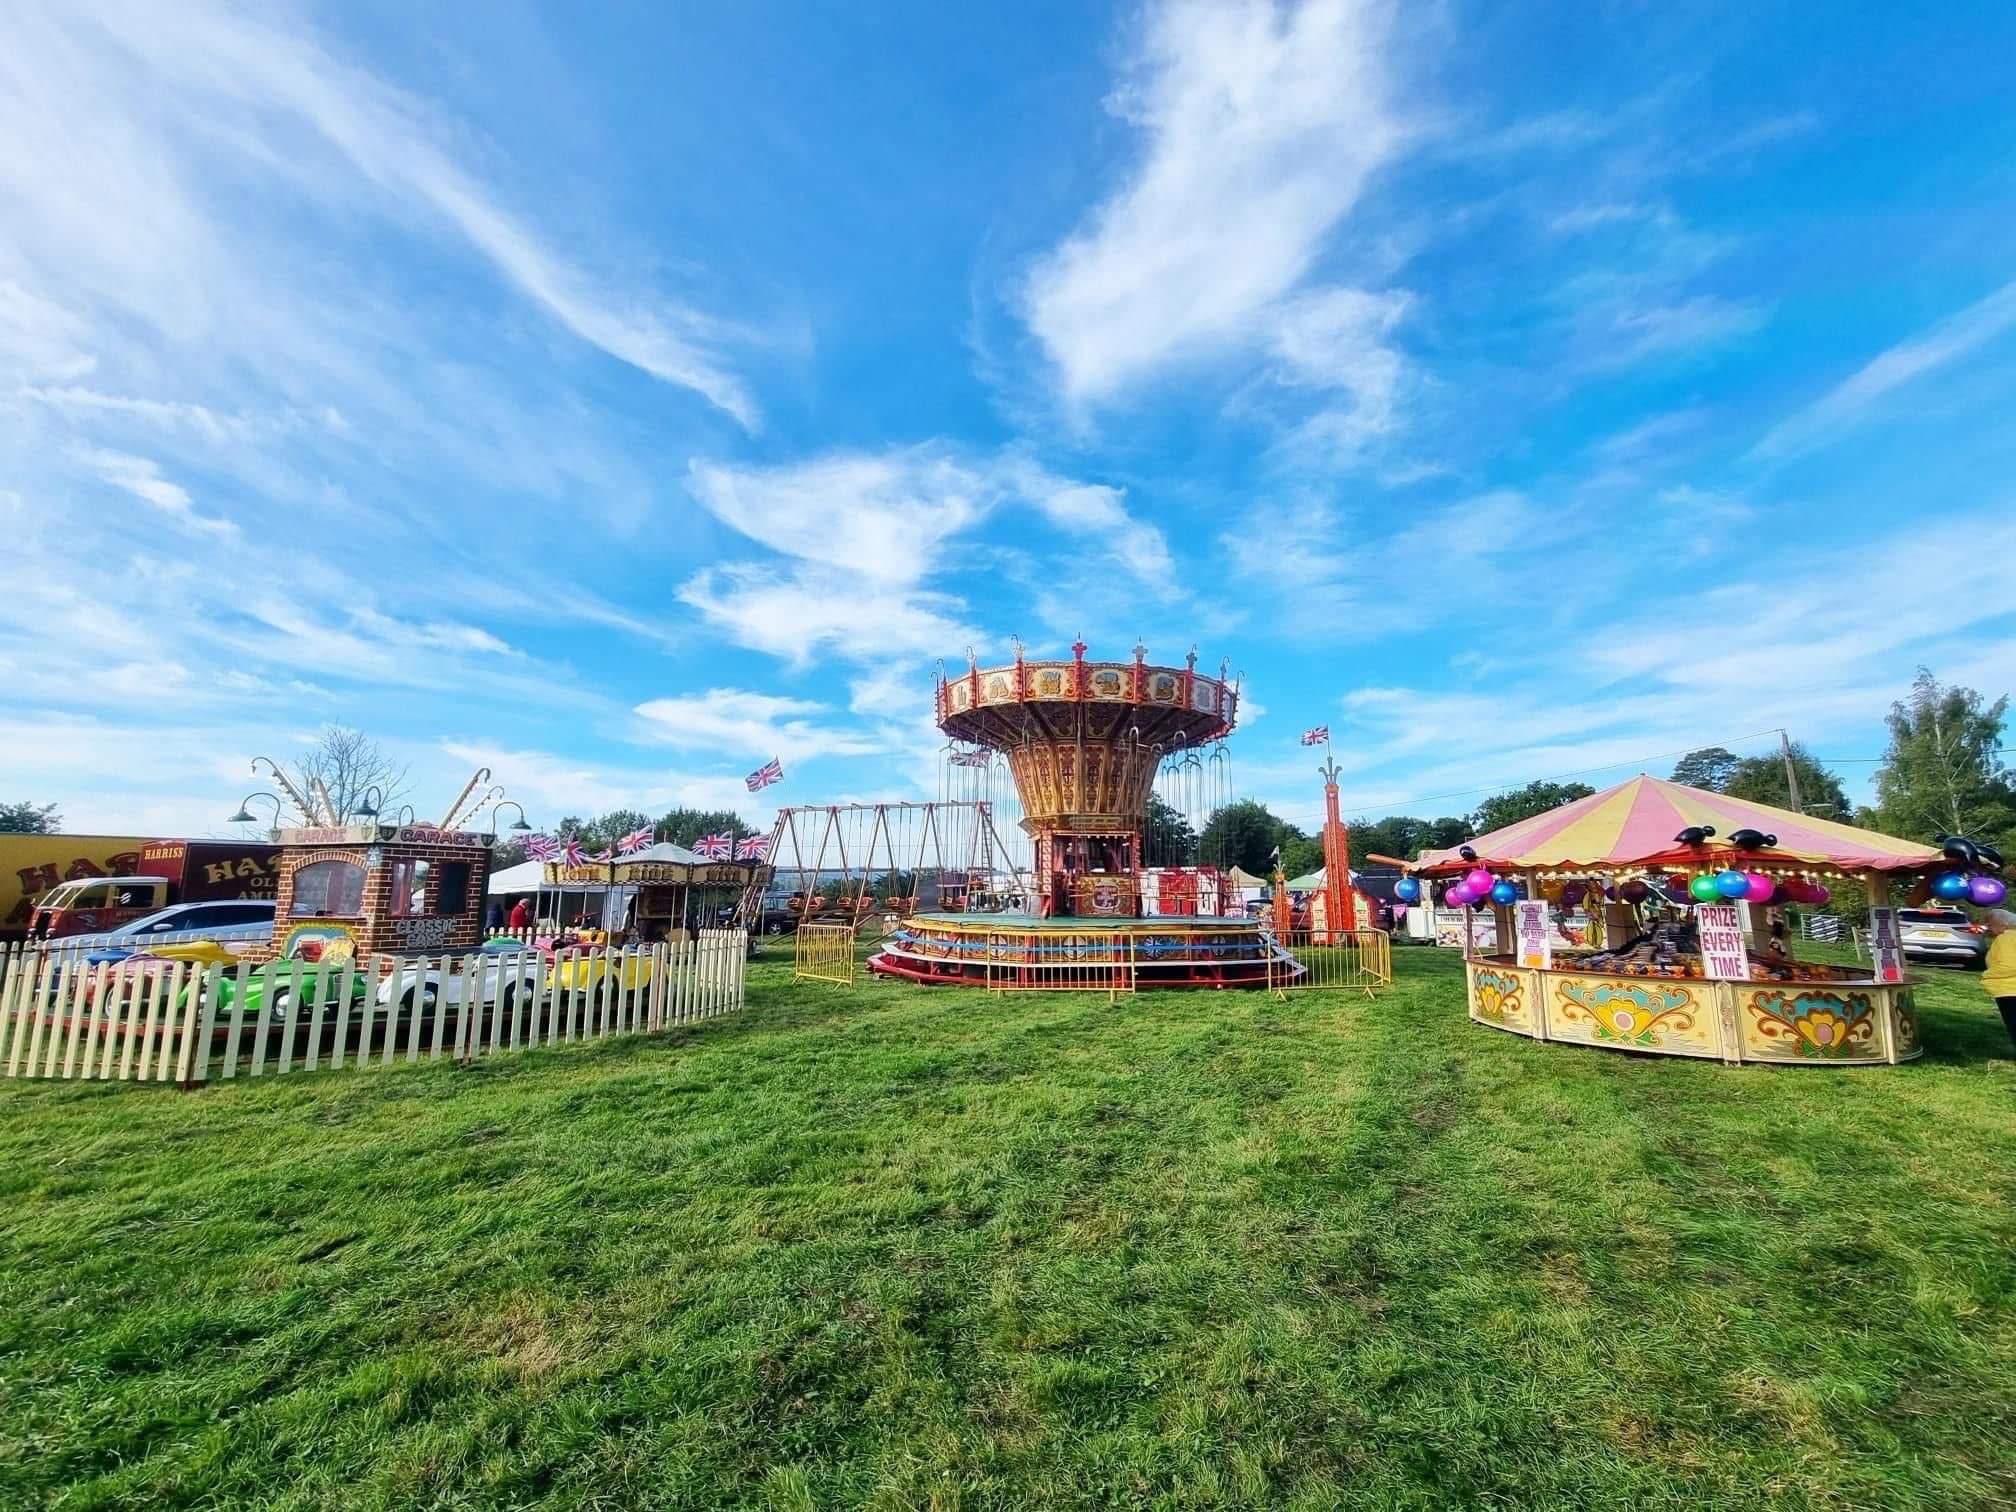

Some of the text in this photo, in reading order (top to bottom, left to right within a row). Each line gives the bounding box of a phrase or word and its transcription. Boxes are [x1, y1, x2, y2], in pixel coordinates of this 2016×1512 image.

[400, 829, 477, 846] GARAGE
[144, 847, 184, 860] HARRISS
[1700, 907, 1737, 928] PRIZE
[395, 918, 457, 935] CLASSIC
[406, 933, 445, 947] CARS
[1702, 931, 1741, 952] EVERY
[1710, 956, 1744, 978] TIME
